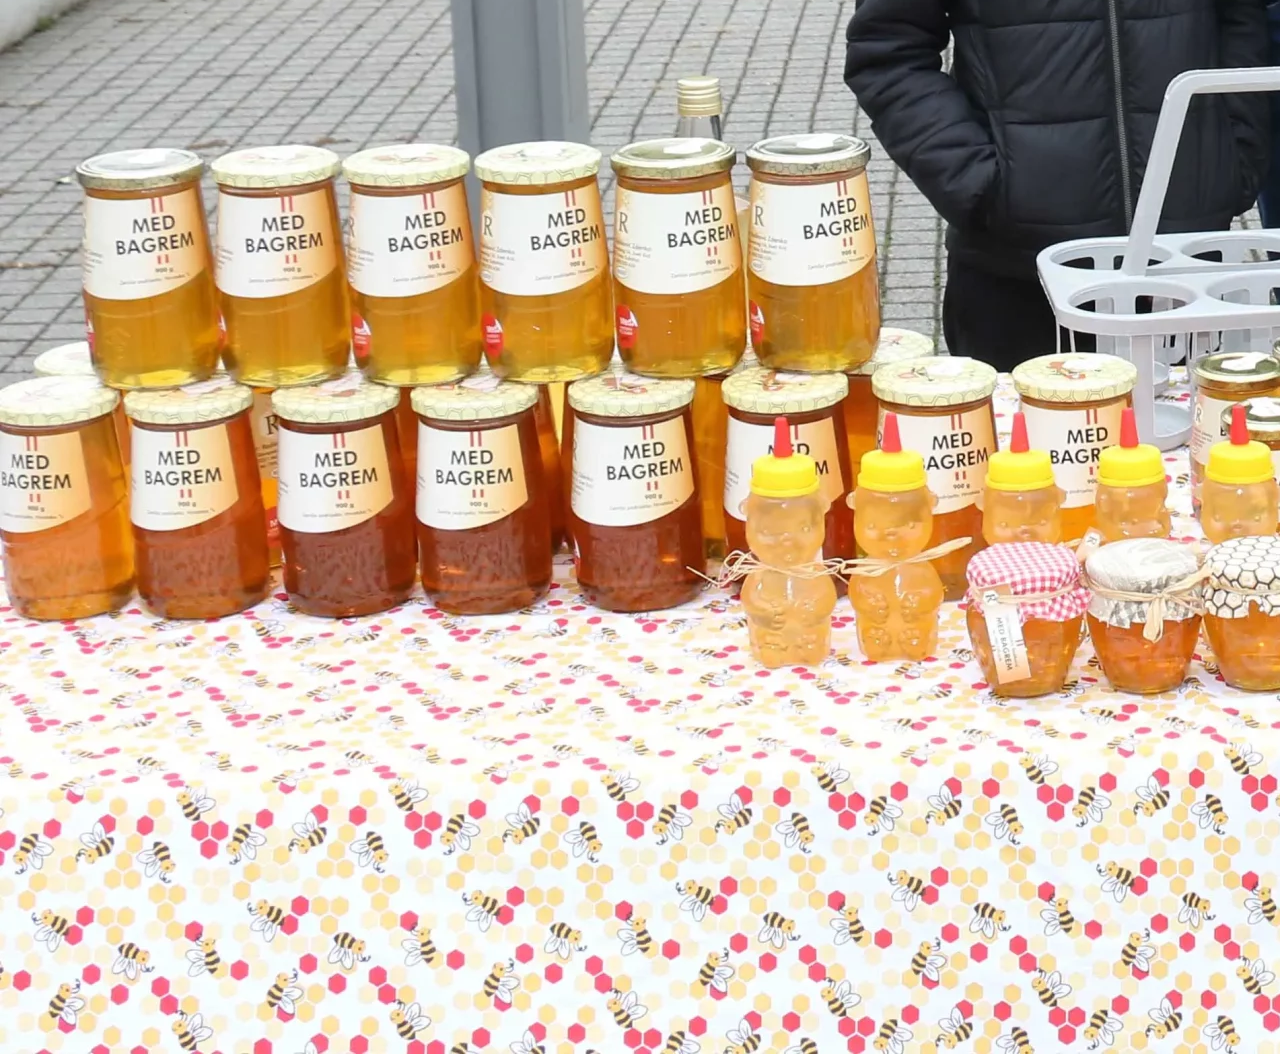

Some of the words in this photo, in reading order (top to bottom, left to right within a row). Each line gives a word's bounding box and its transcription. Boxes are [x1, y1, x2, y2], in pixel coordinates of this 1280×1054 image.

[684, 206, 723, 227] MED
[820, 197, 857, 218] MED
[132, 214, 176, 234] MED
[261, 214, 305, 233] MED
[405, 211, 447, 231] MED
[547, 208, 586, 228] MED
[803, 214, 869, 239] BAGREM
[116, 232, 194, 255] BAGREM
[245, 232, 324, 254] BAGREM
[388, 227, 464, 253] BAGREM
[530, 224, 601, 251] BAGREM
[667, 224, 735, 248] BAGREM
[932, 432, 973, 451] MED
[1066, 426, 1109, 445] MED
[157, 449, 201, 466] MED
[314, 450, 358, 468] MED
[450, 450, 494, 466] MED
[623, 441, 666, 460] MED
[922, 448, 989, 470] AGREM
[1050, 444, 1116, 465] BAGR
[10, 453, 50, 471] MED
[606, 457, 684, 481] BAGREM
[1, 472, 72, 491] BAGREM
[145, 466, 222, 486] BAGREM
[299, 467, 378, 488] BAGREM
[435, 467, 514, 486] BAGREM
